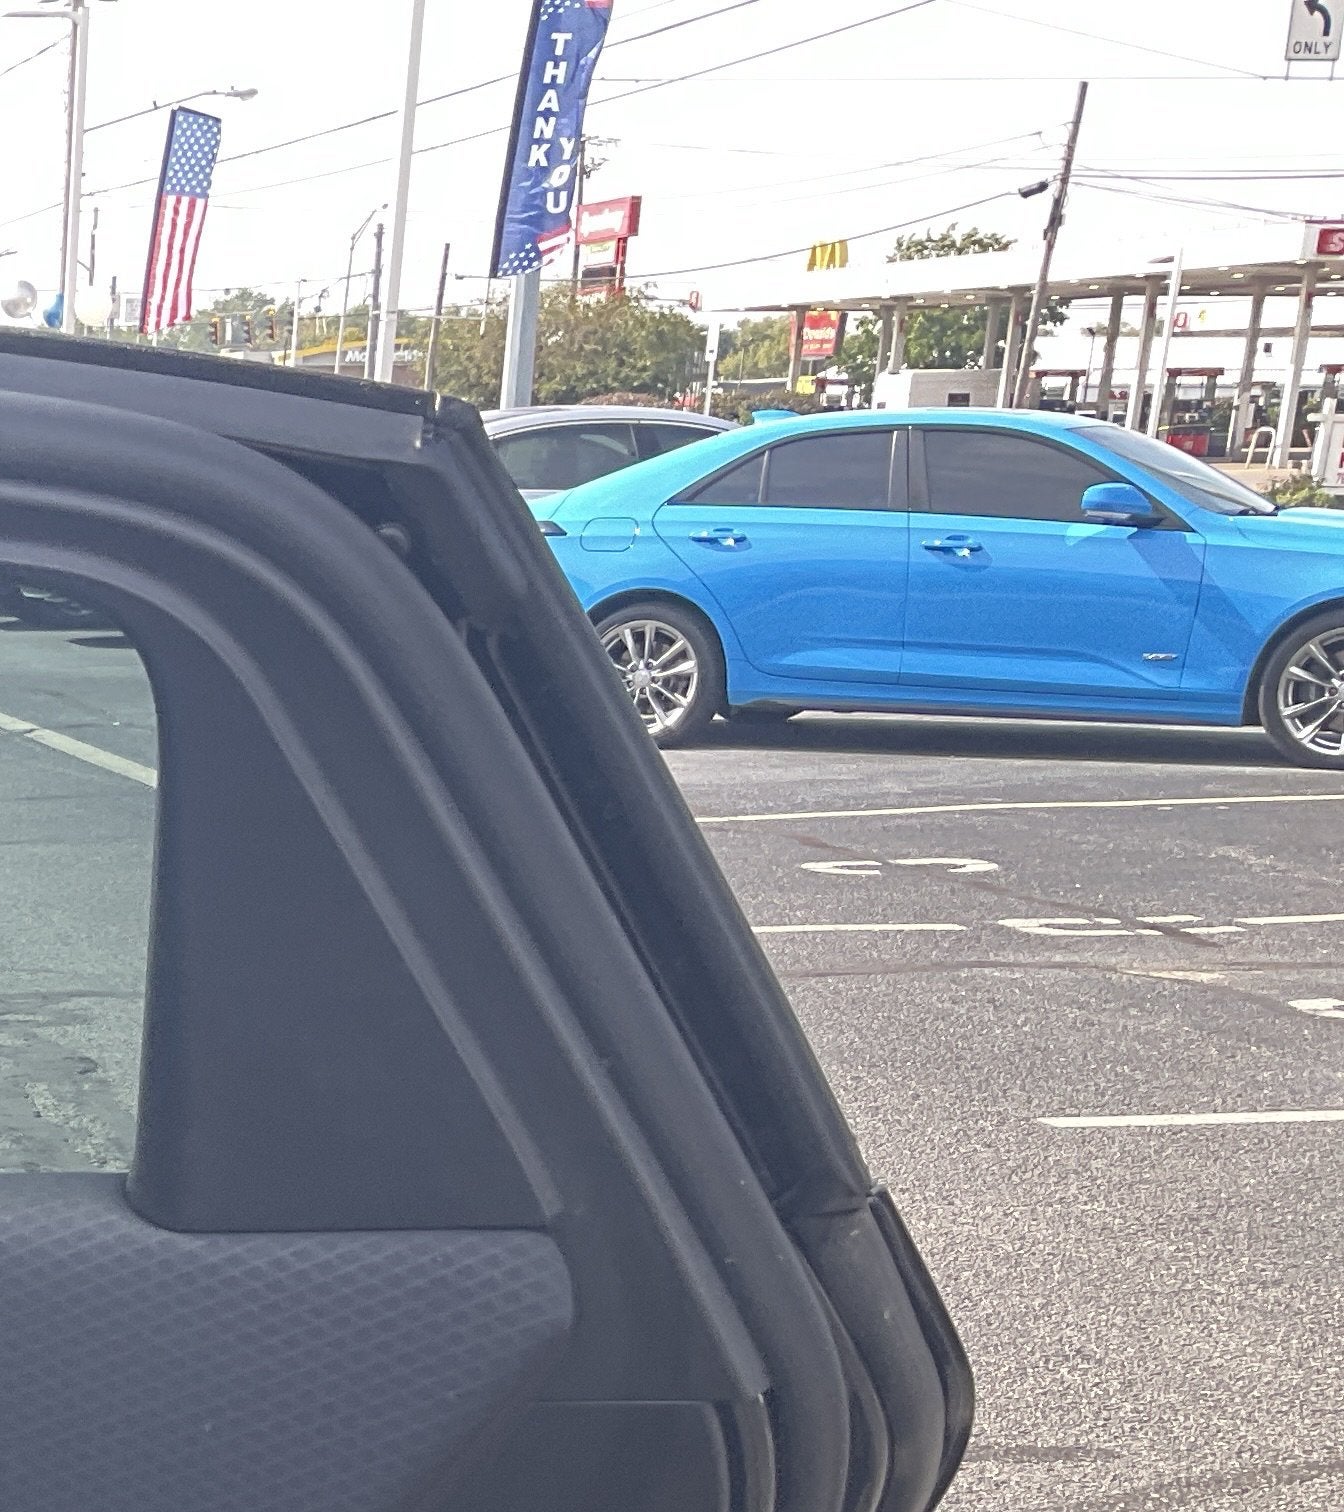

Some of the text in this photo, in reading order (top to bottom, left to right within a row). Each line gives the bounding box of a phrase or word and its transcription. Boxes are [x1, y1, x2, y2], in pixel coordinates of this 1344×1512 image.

[1293, 41, 1333, 55] ONLY
[527, 33, 576, 214] THANK YOU
